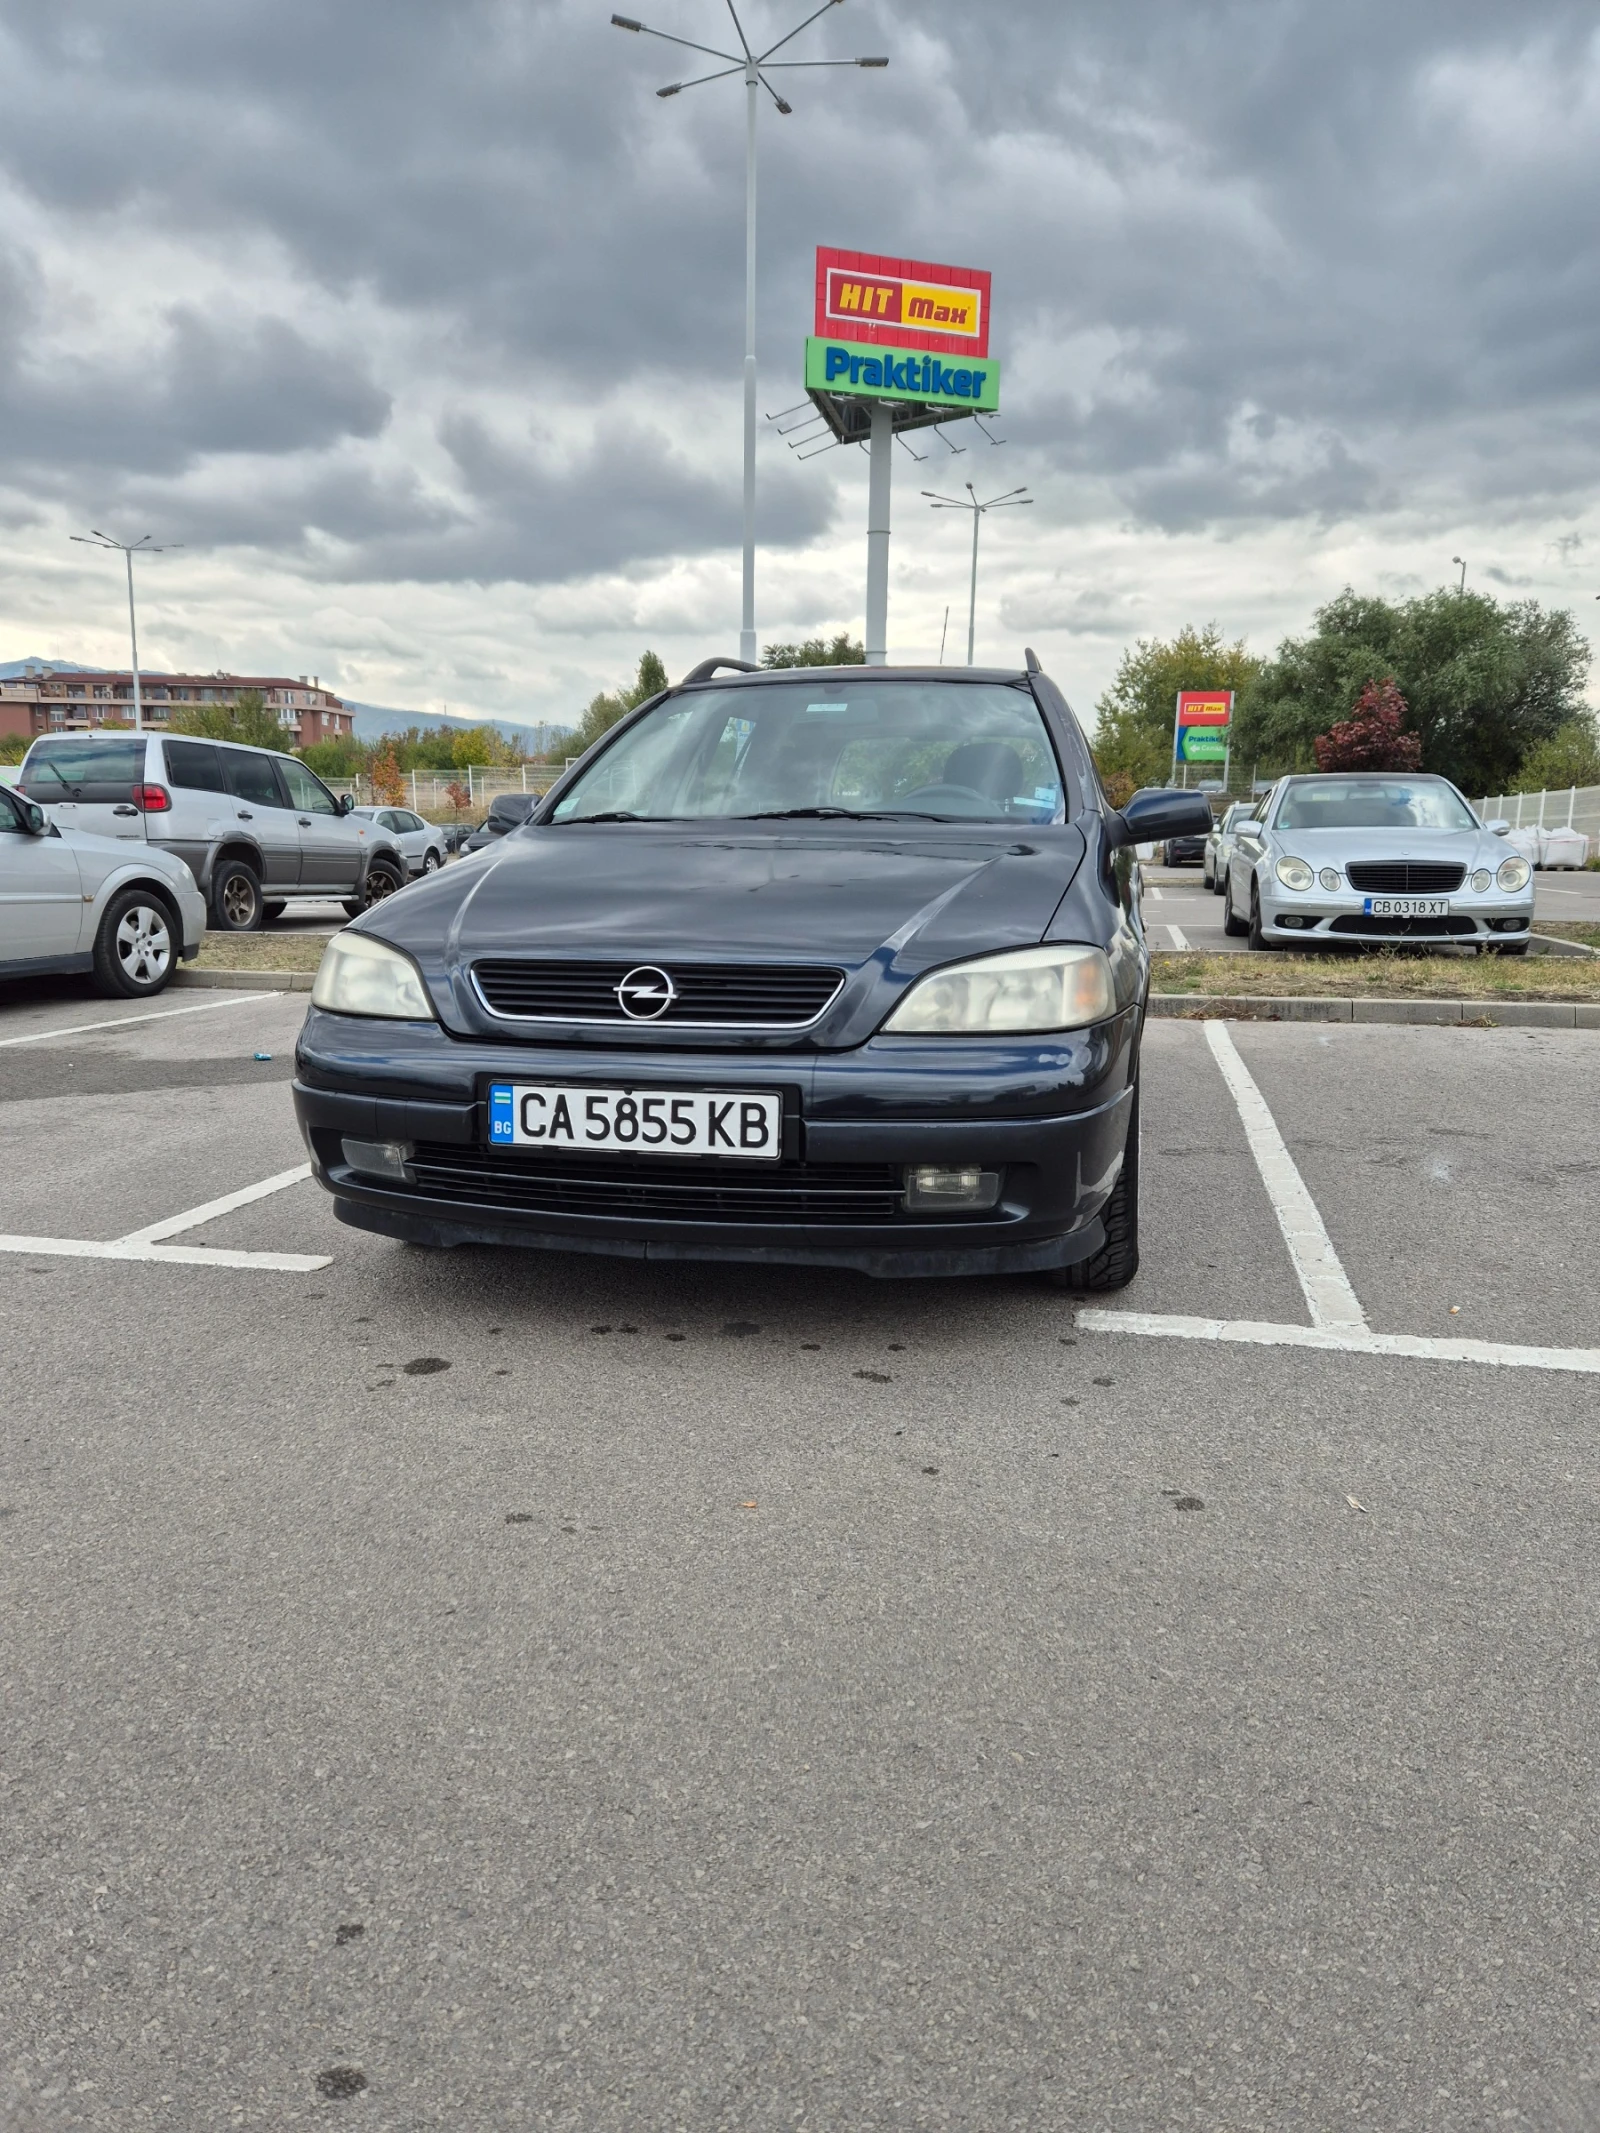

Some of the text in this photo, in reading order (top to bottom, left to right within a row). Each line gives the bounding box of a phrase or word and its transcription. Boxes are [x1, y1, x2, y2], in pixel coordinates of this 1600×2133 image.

[839, 282, 968, 324] HIT Max
[825, 346, 987, 398] Praktiker
[1373, 901, 1391, 913] CB
[1393, 901, 1426, 914] 0318
[1428, 901, 1446, 914] XT
[494, 1120, 512, 1135] BG
[520, 1092, 769, 1149] CA 5855 KB
